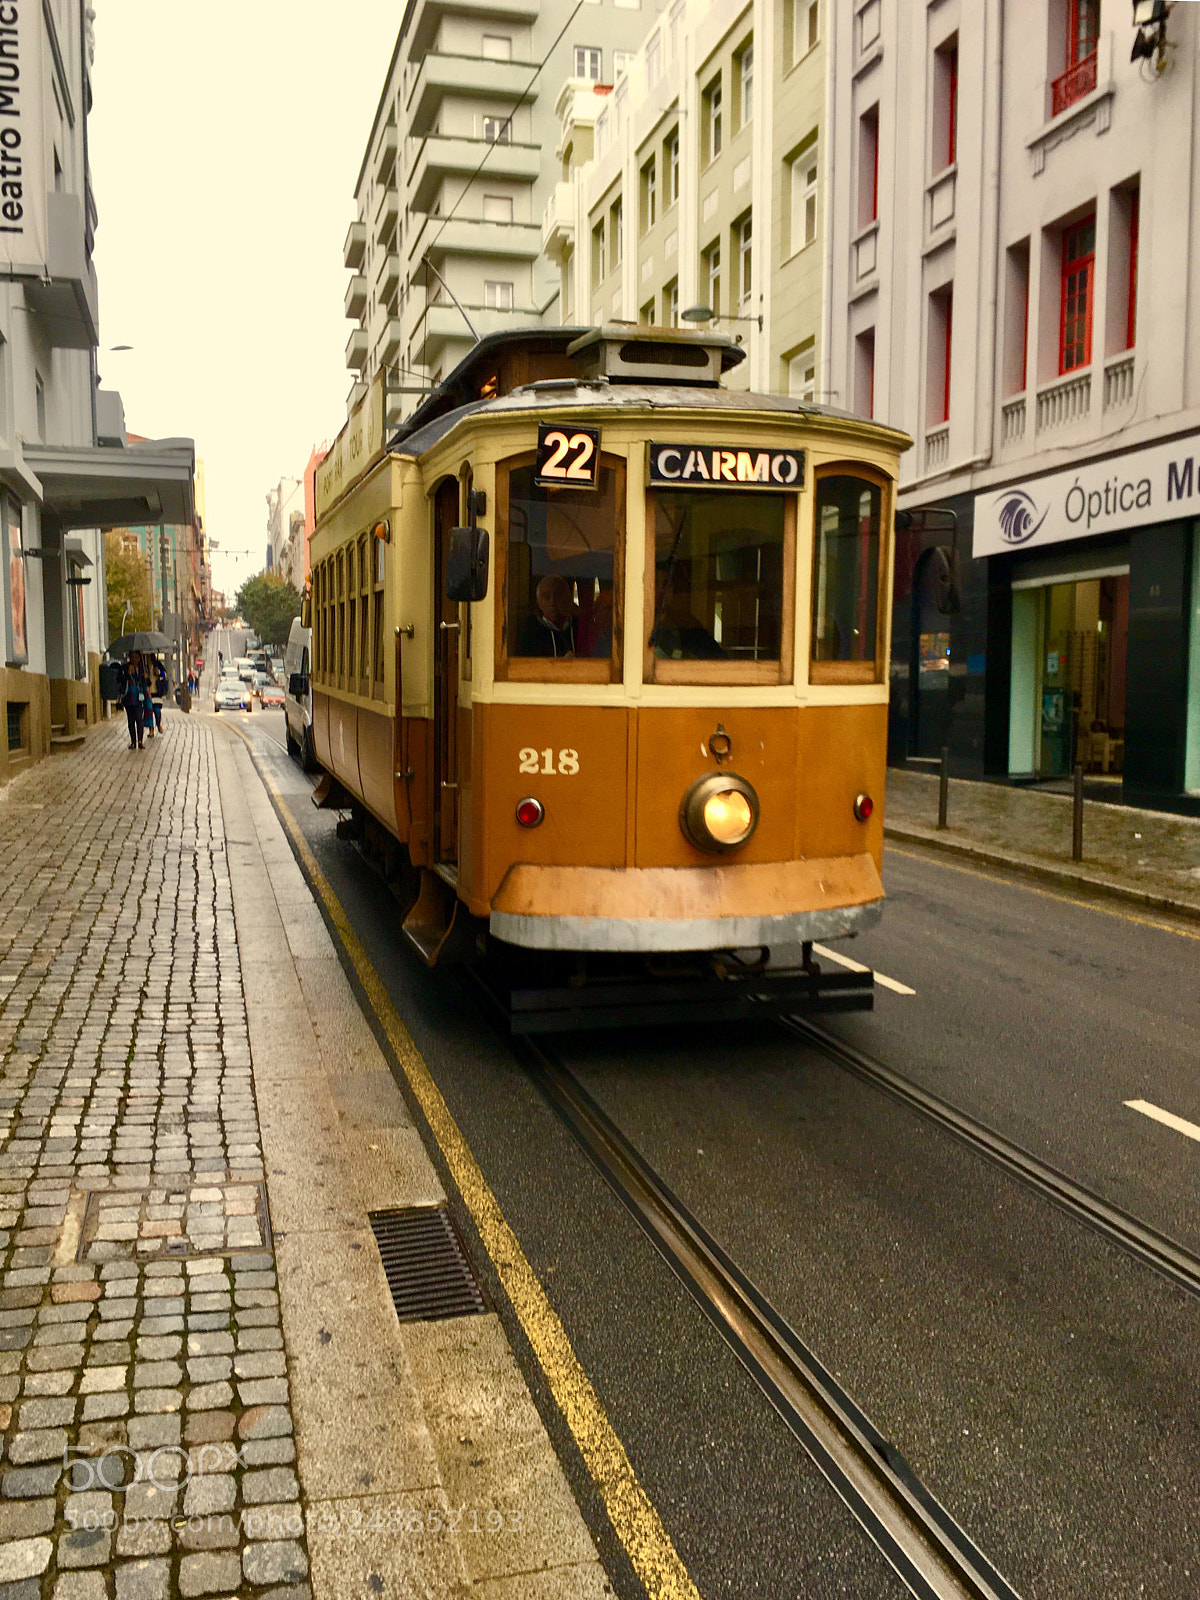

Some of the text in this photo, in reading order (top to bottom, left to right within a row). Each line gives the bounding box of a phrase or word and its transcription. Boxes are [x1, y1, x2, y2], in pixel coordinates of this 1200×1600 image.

[540, 431, 594, 480] 22
[657, 449, 798, 484] CARMO
[1065, 457, 1200, 529] Óptica M
[519, 747, 580, 775] 218
